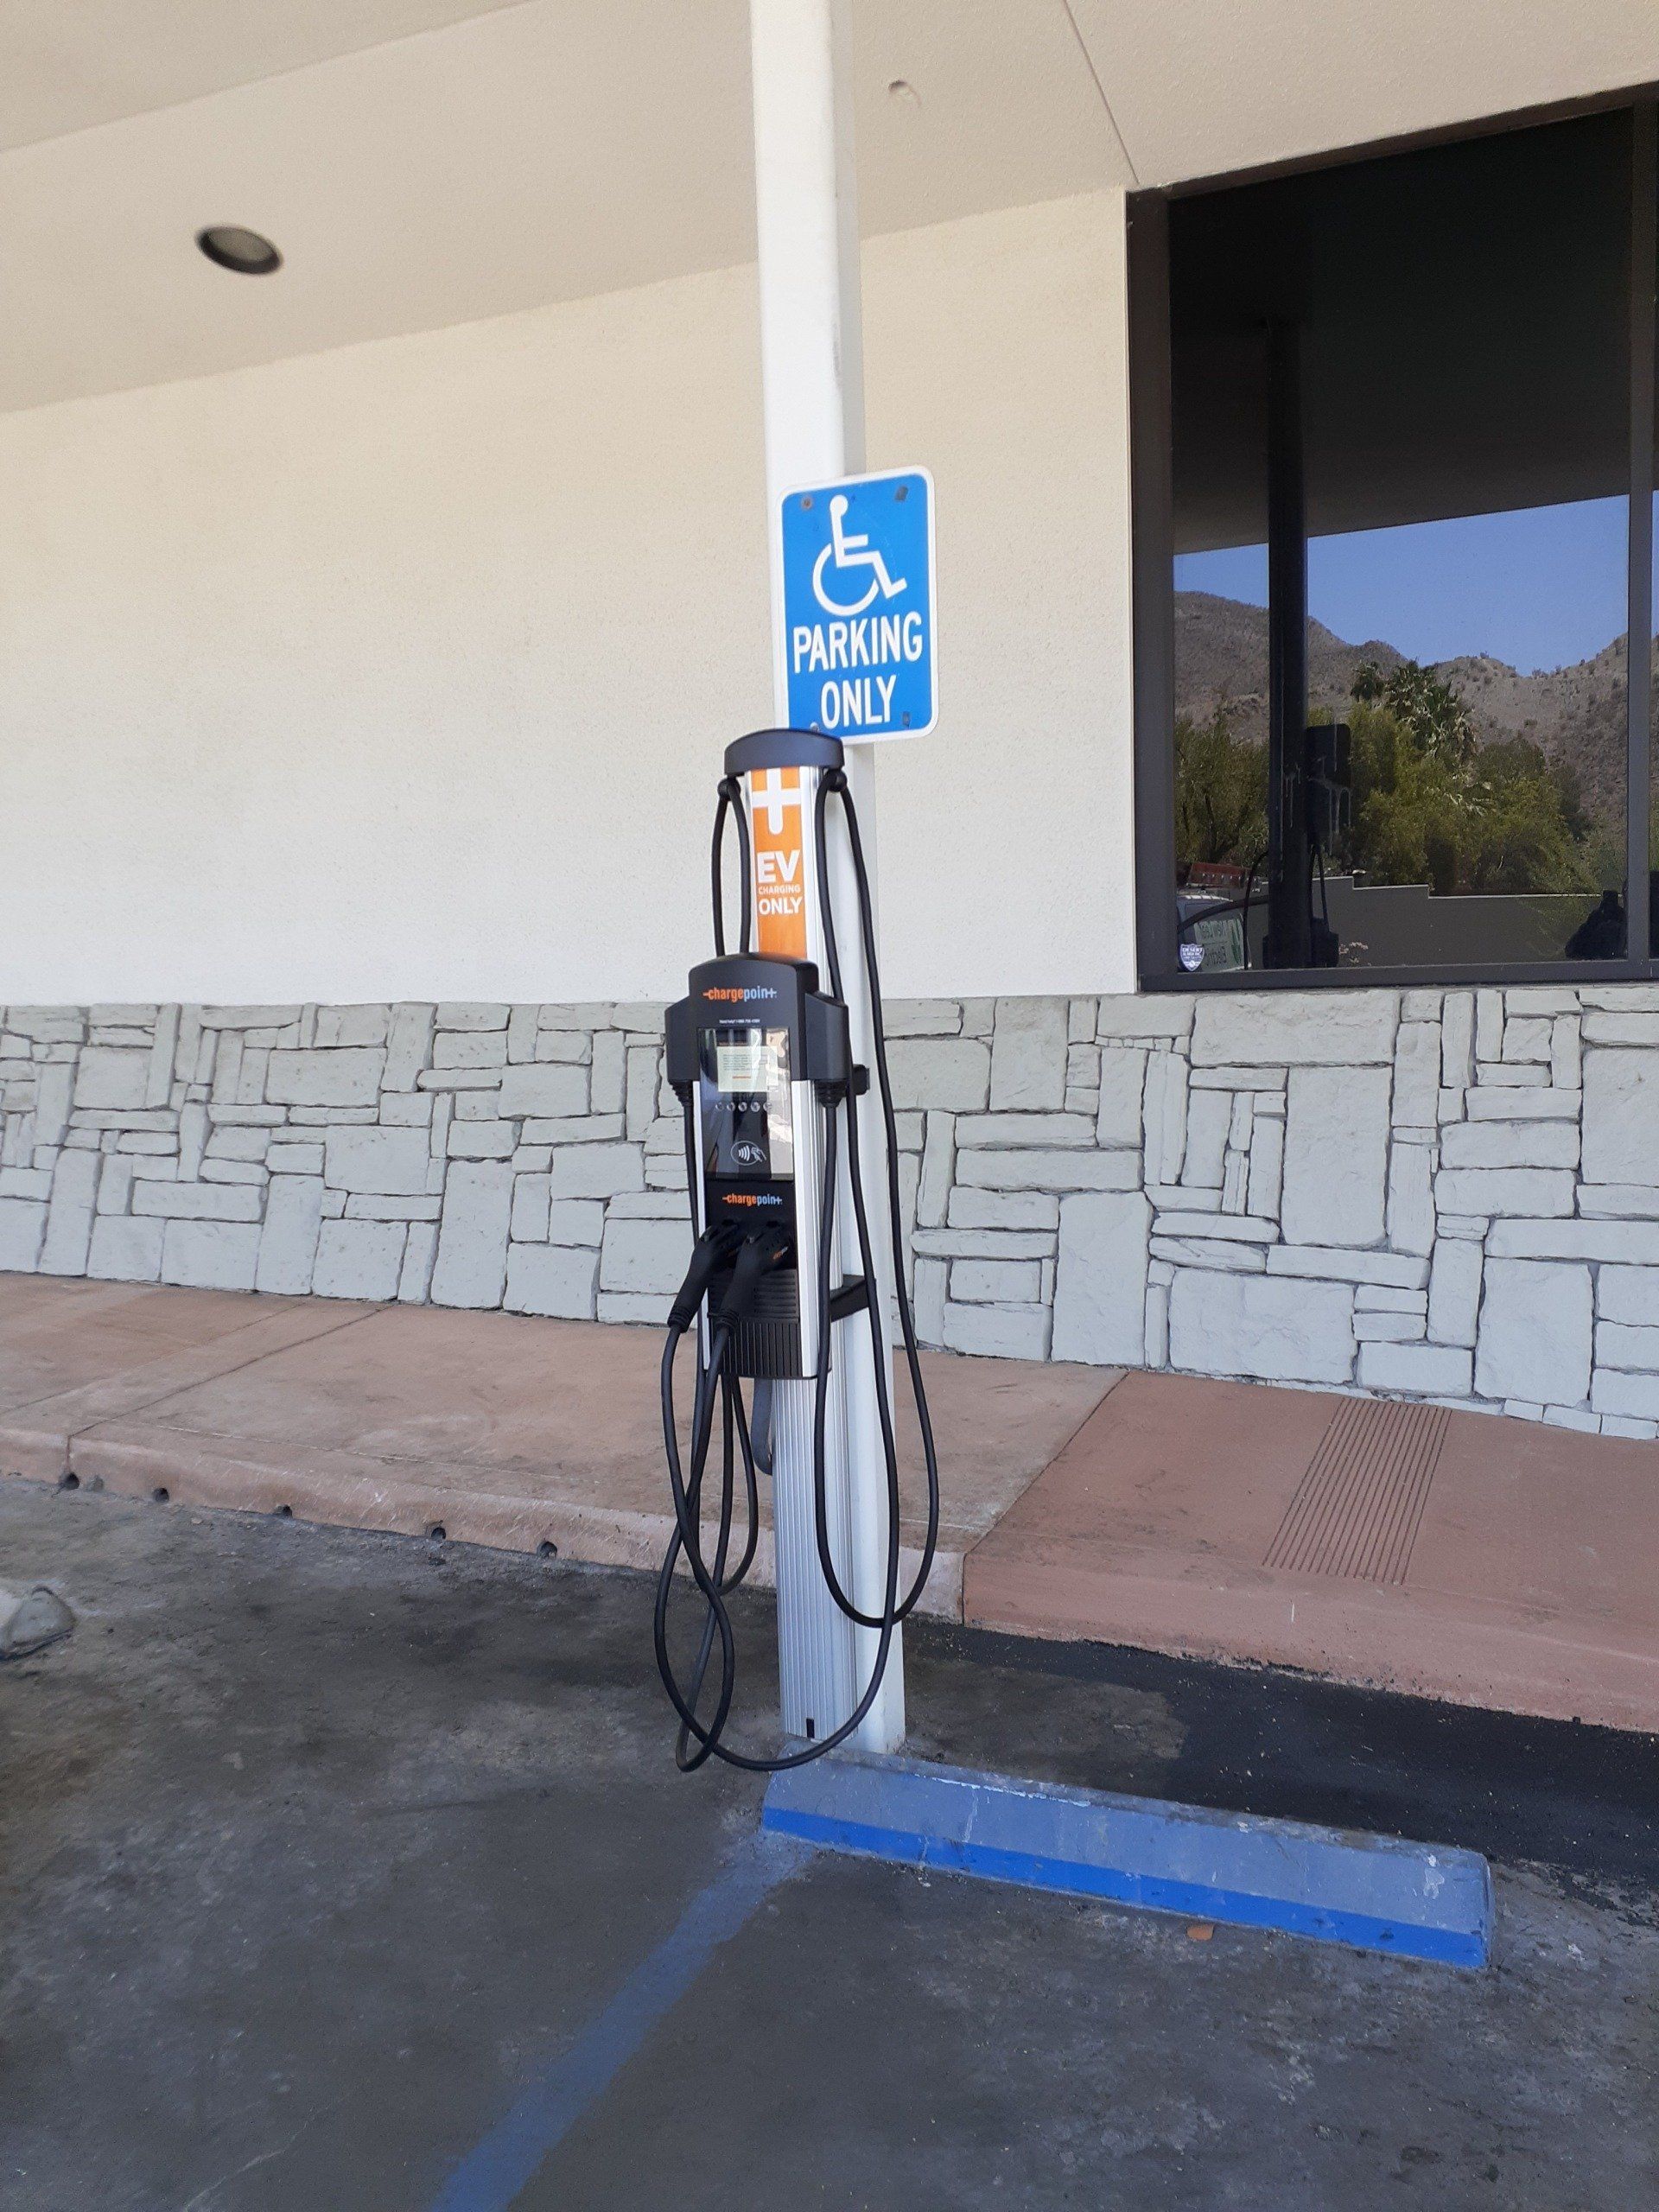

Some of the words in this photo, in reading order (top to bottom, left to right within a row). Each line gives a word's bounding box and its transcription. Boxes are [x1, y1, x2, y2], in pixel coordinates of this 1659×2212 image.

[793, 611, 923, 674] PARKING
[821, 674, 897, 729] ONLY
[757, 849, 801, 883] EV
[758, 884, 801, 894] CHARGING
[759, 896, 803, 915] ONLY
